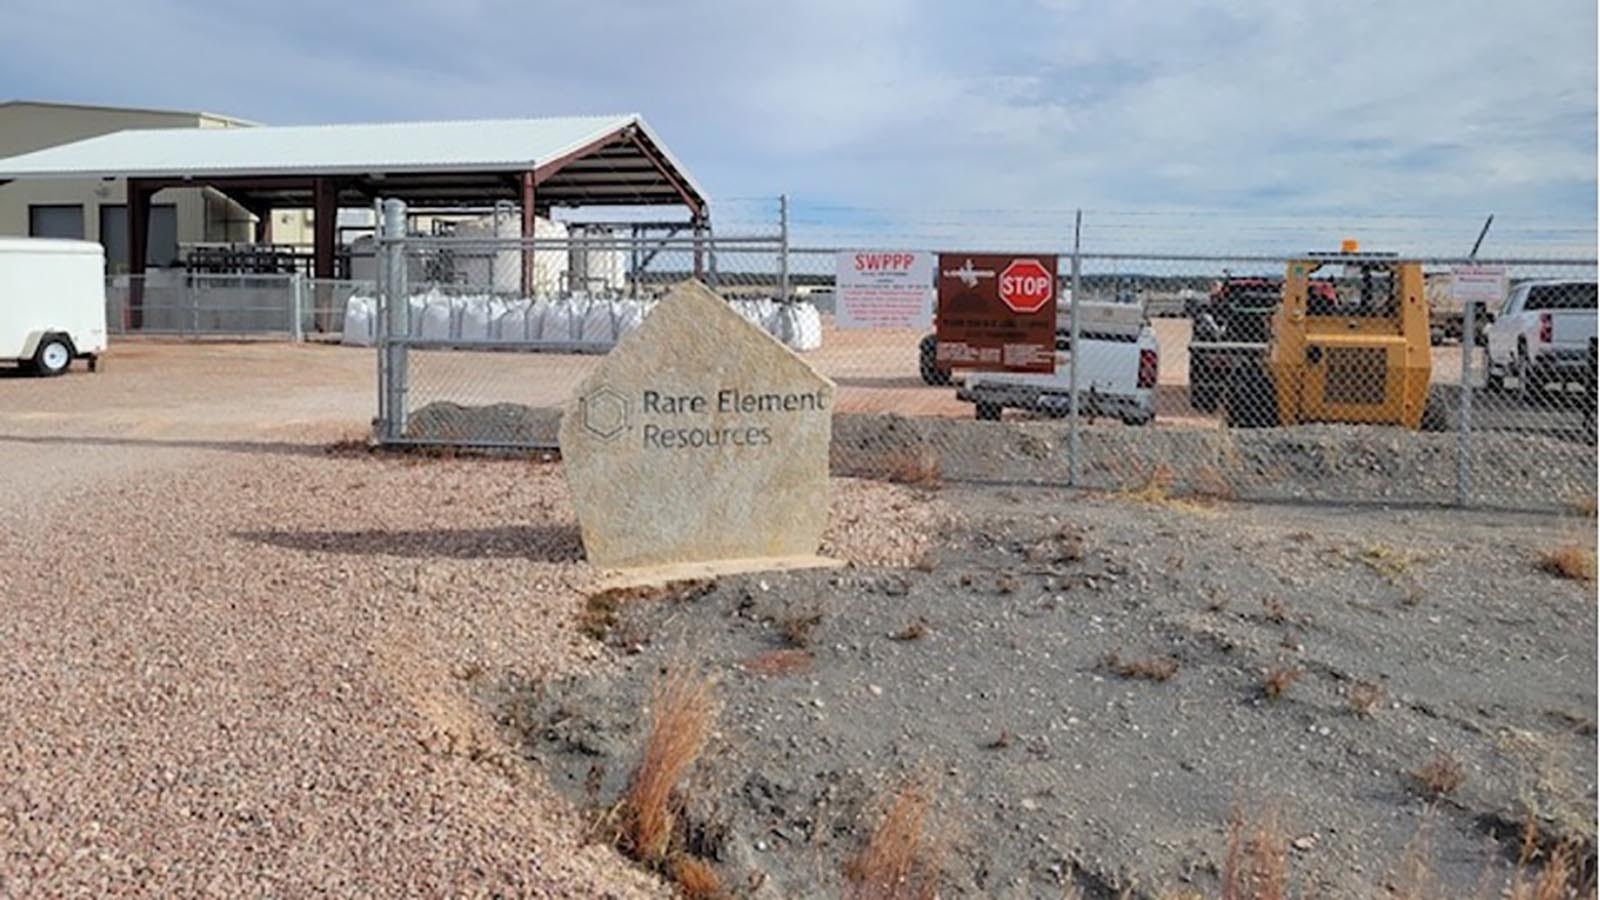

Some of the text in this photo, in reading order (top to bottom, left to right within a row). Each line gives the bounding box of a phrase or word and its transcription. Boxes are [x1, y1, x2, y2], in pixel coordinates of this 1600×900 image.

[855, 253, 914, 271] SWPPP
[1002, 276, 1048, 295] STOP
[643, 388, 825, 413] Rare Element
[643, 424, 772, 448] Resources
